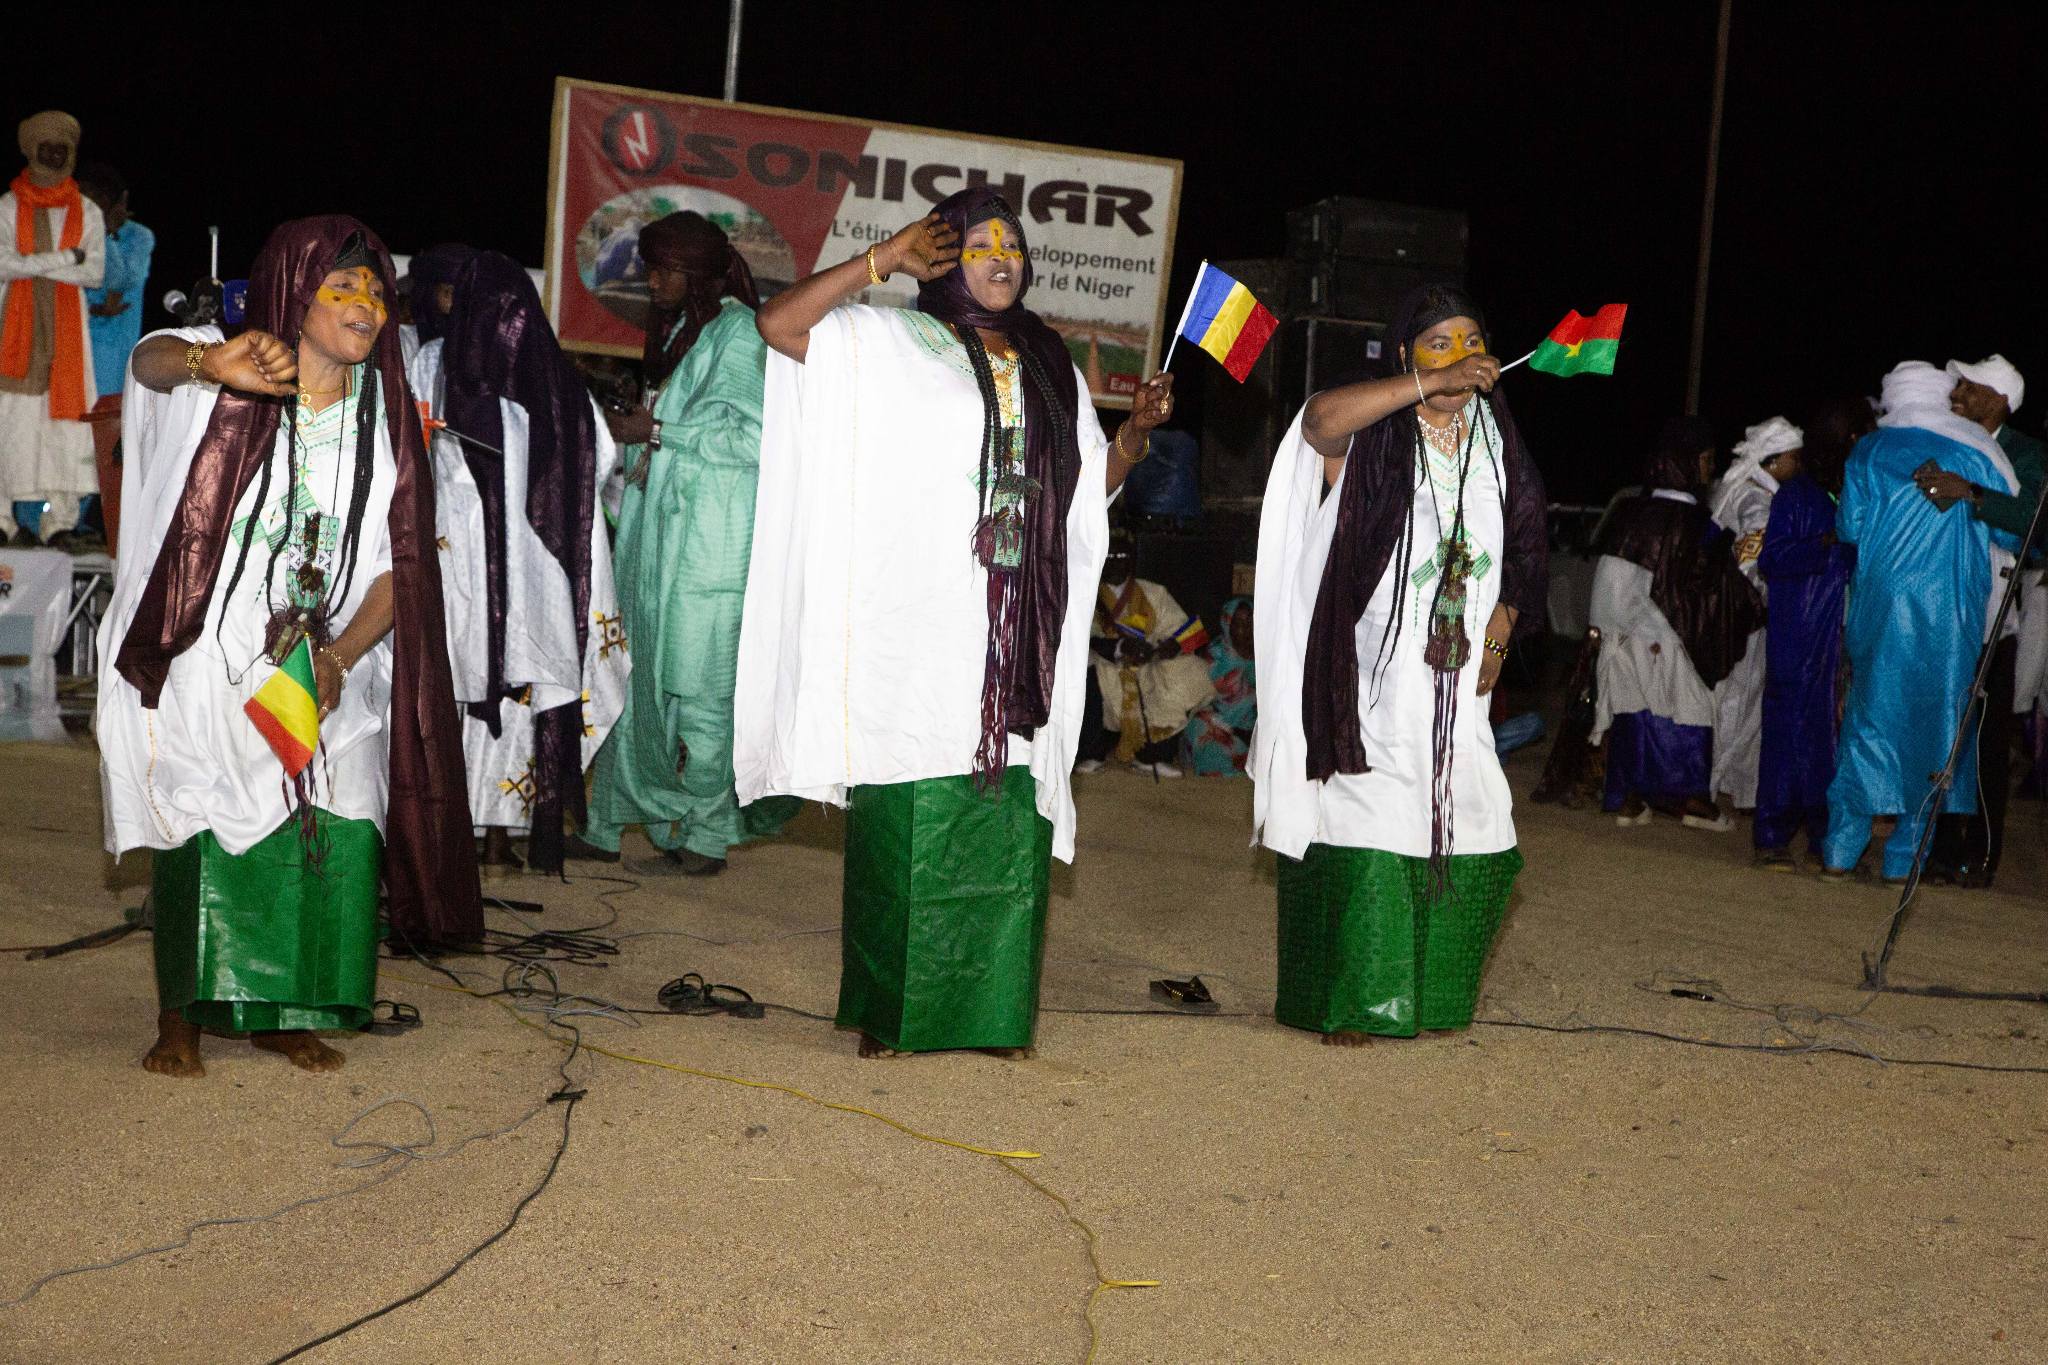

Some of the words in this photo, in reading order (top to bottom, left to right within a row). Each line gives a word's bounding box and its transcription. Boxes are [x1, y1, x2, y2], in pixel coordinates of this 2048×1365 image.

[680, 132, 1154, 237] SONICHAR
[832, 219, 893, 242] L'étin
[1029, 244, 1156, 275] eloppement
[1075, 275, 1135, 300] Niger
